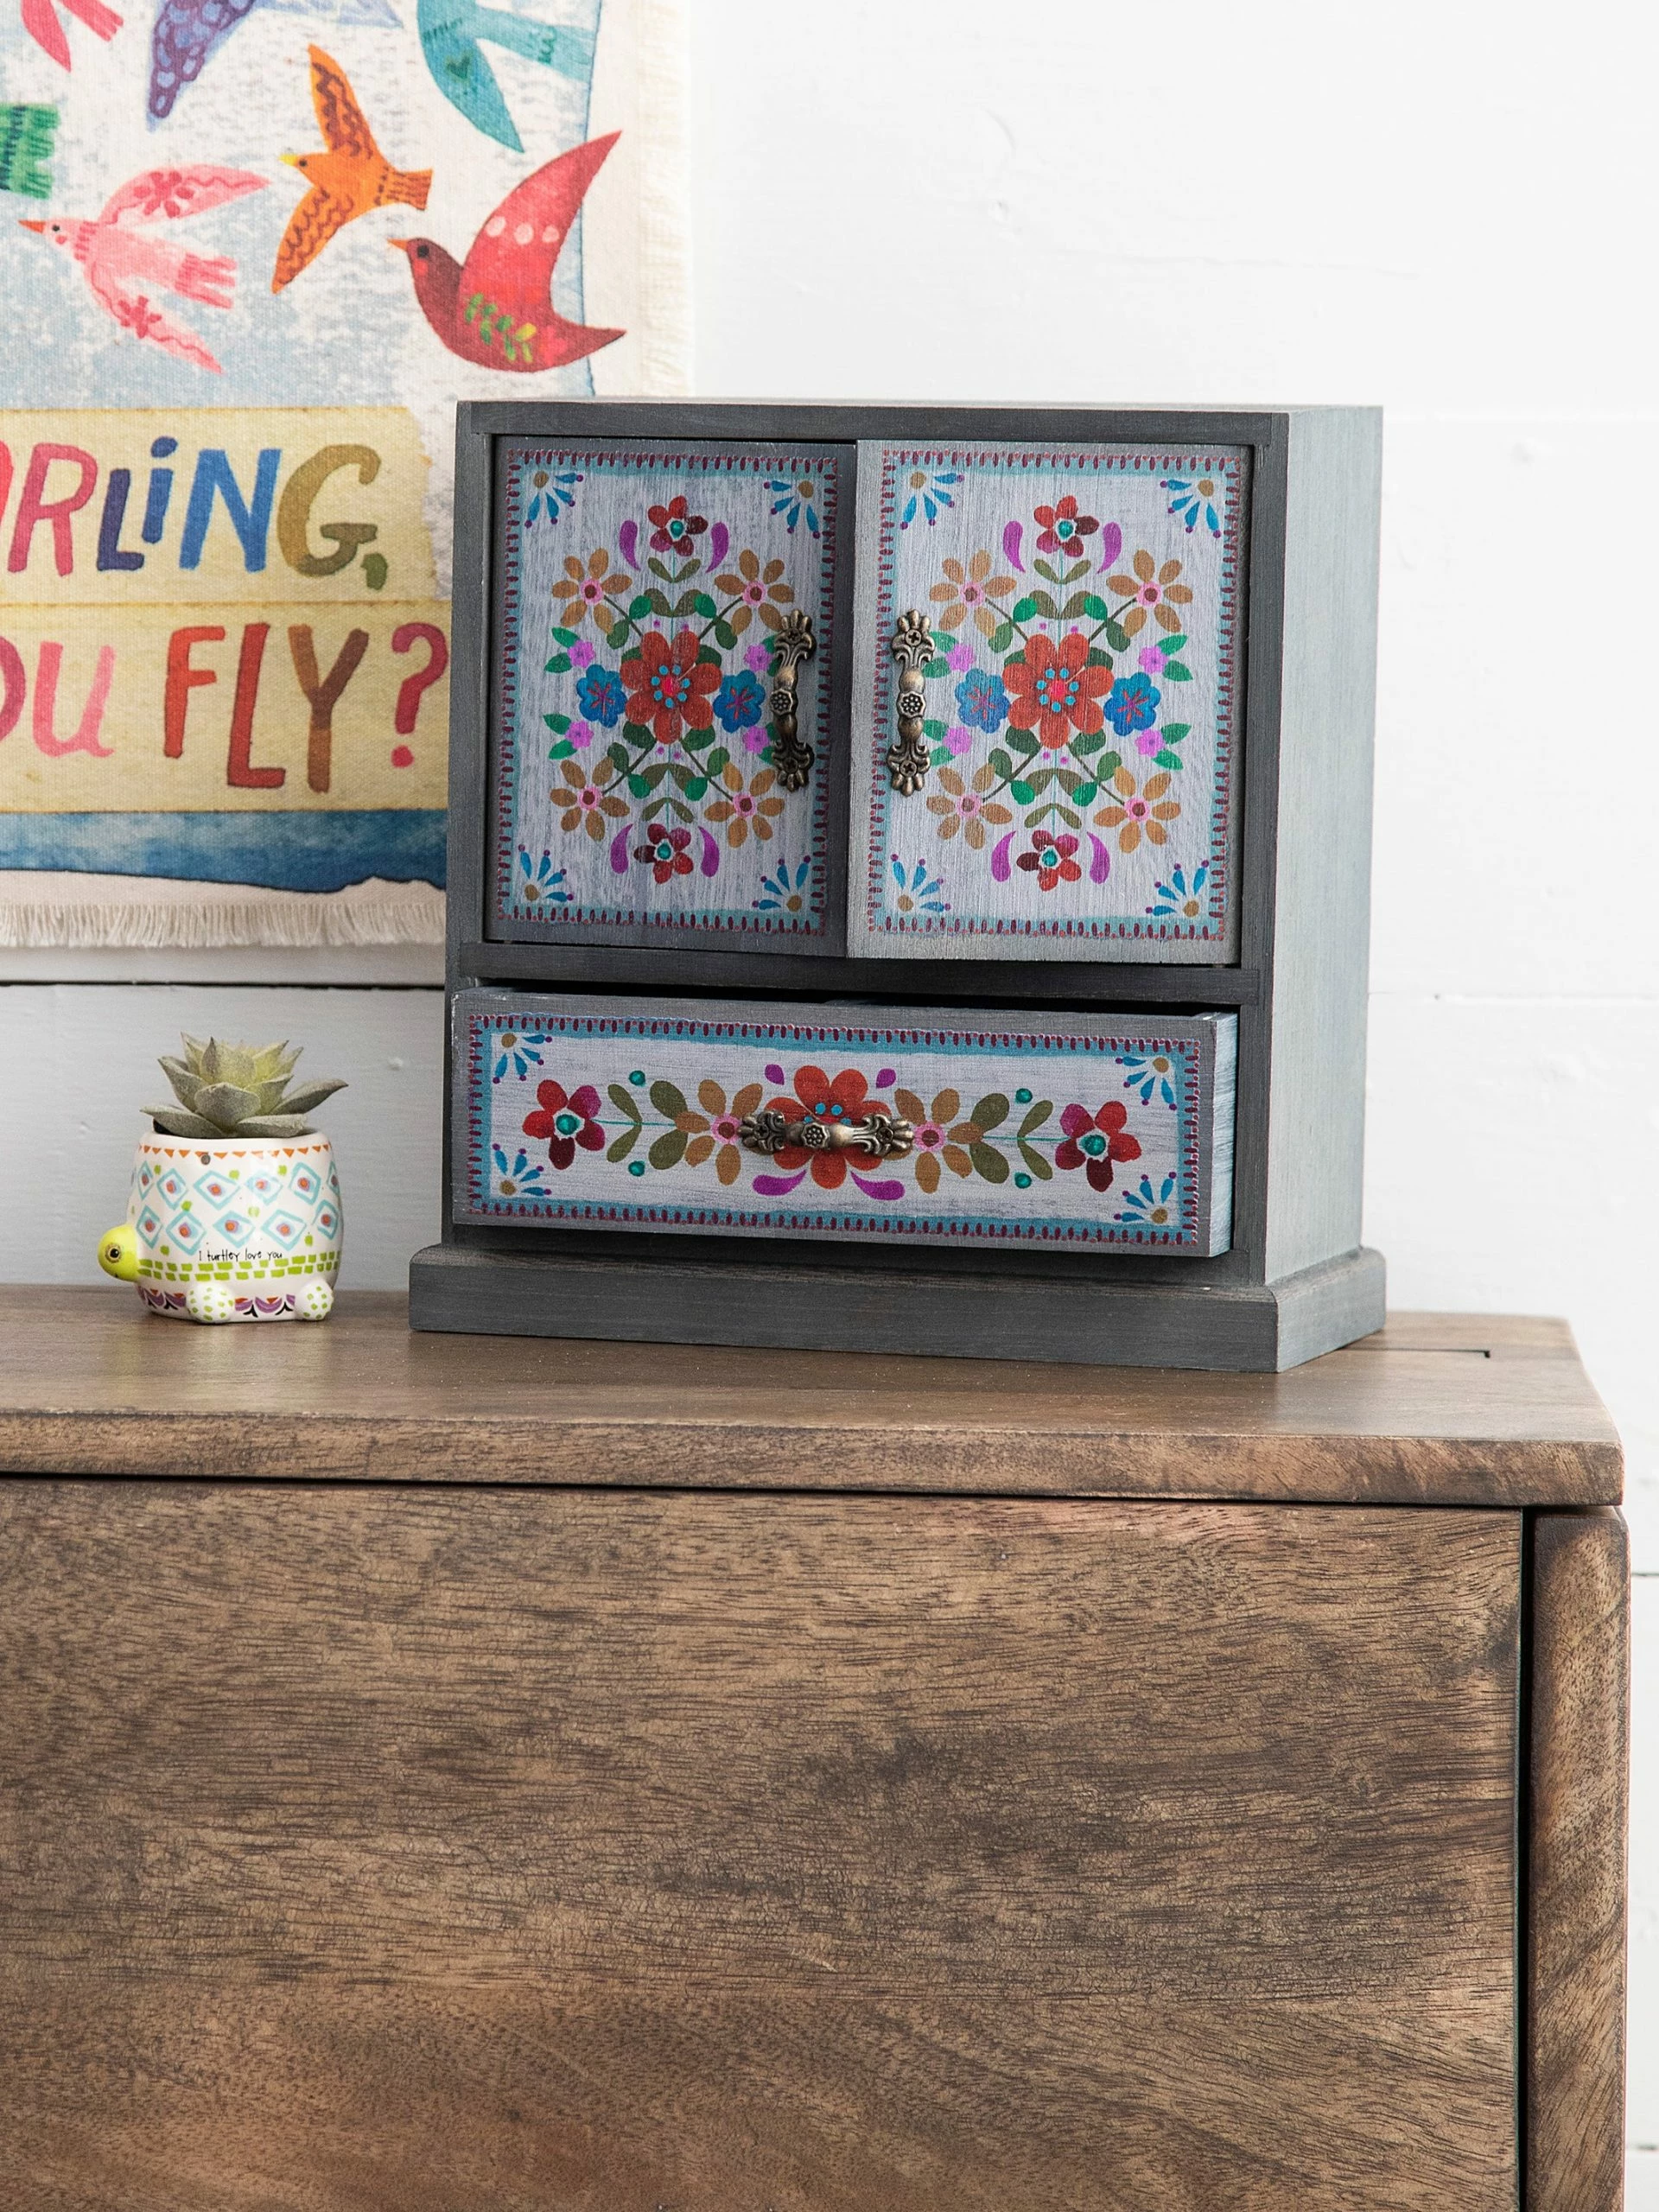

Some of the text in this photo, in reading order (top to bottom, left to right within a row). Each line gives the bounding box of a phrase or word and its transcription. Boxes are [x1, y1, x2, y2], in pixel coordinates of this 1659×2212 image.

[163, 622, 448, 793] FLY?
[199, 1247, 283, 1262] I turtley love you
